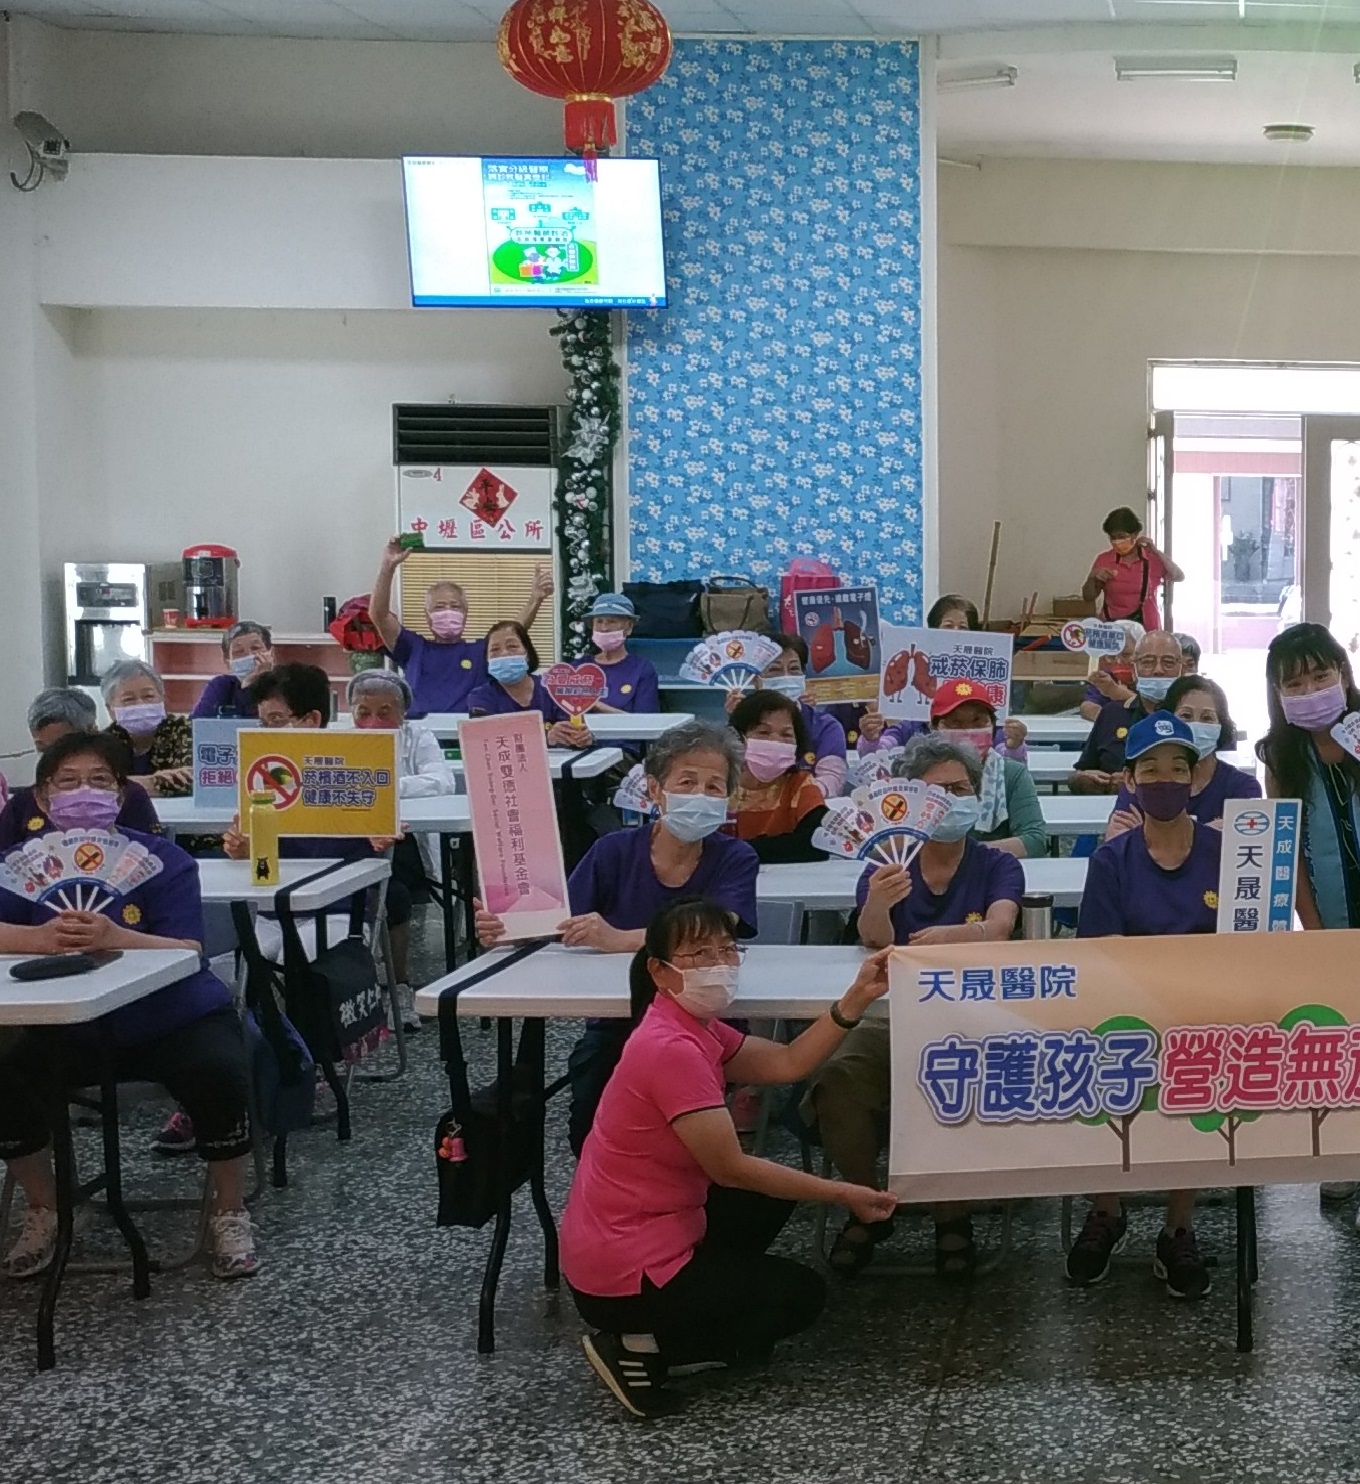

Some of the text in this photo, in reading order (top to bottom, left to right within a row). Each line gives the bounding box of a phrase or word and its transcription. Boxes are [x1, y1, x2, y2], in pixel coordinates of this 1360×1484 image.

[433, 468, 442, 482] 4
[411, 517, 544, 540] 中壢區公所
[930, 656, 1008, 680] 戒菸保肺
[200, 745, 237, 765] 電子
[303, 770, 390, 786] 菸檳酒不入口
[303, 789, 376, 806] 健康不失守
[496, 735, 530, 896] 天成雙德社會福利基金會
[917, 965, 1078, 1003] 天晟醫院
